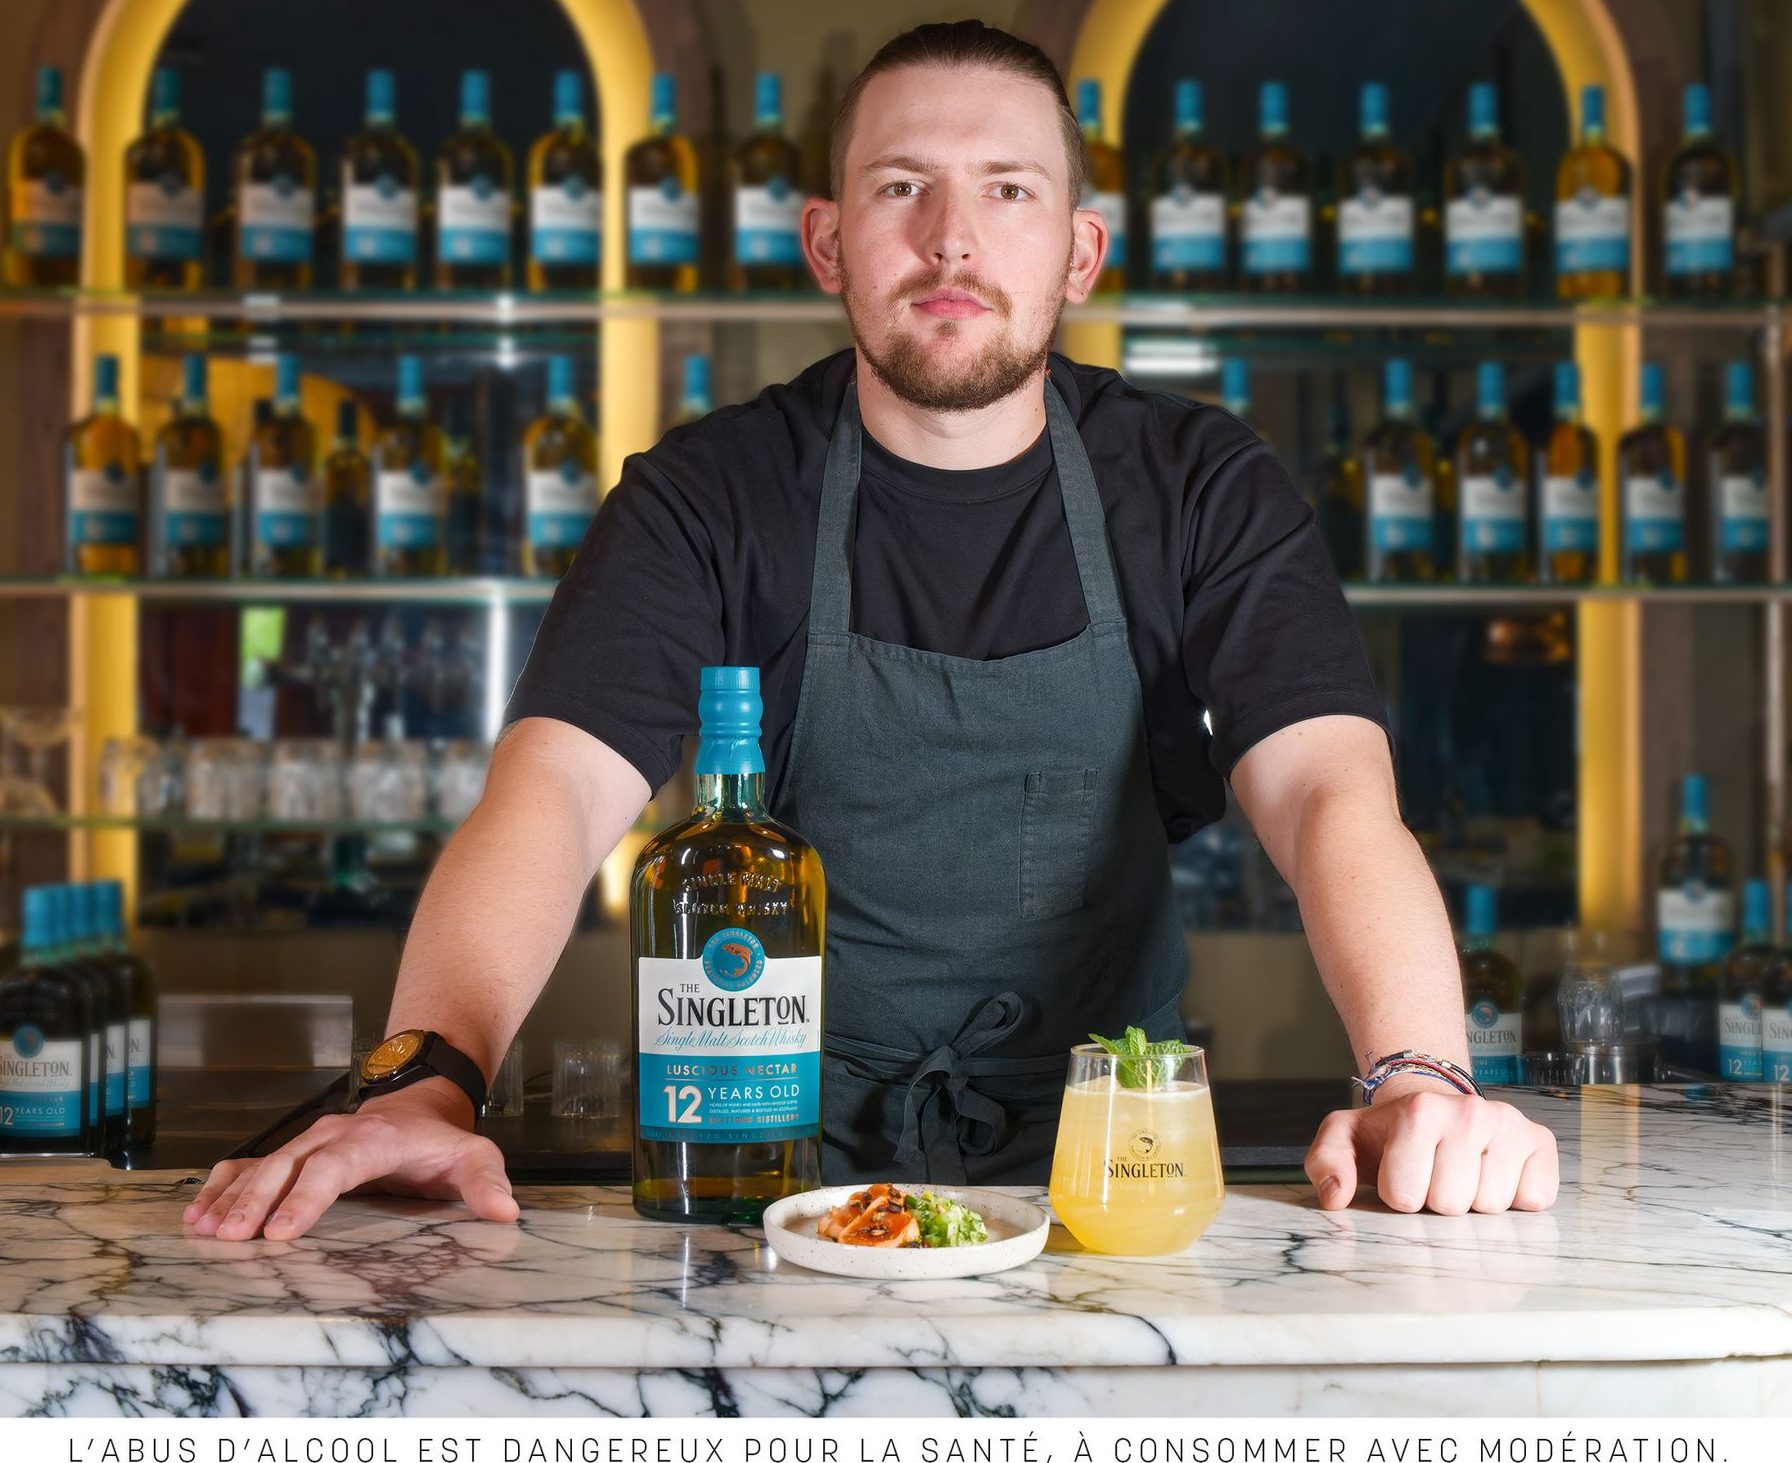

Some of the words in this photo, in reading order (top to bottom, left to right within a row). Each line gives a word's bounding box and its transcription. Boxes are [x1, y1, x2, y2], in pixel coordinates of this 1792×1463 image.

[680, 983, 700, 993] THE
[658, 988, 807, 1027] SINGLETON
[656, 1026, 697, 1050] Single
[695, 1029, 728, 1047] Malt
[726, 1028, 768, 1048] Scotch
[767, 1026, 807, 1049] Whisky
[666, 1064, 738, 1076] LUSCIOUS
[745, 1063, 797, 1076] NECTAR
[708, 1086, 764, 1100] YEARS
[770, 1084, 800, 1098] OLD
[663, 1085, 703, 1124] 12
[1104, 1159, 1184, 1178] SINGLETON
